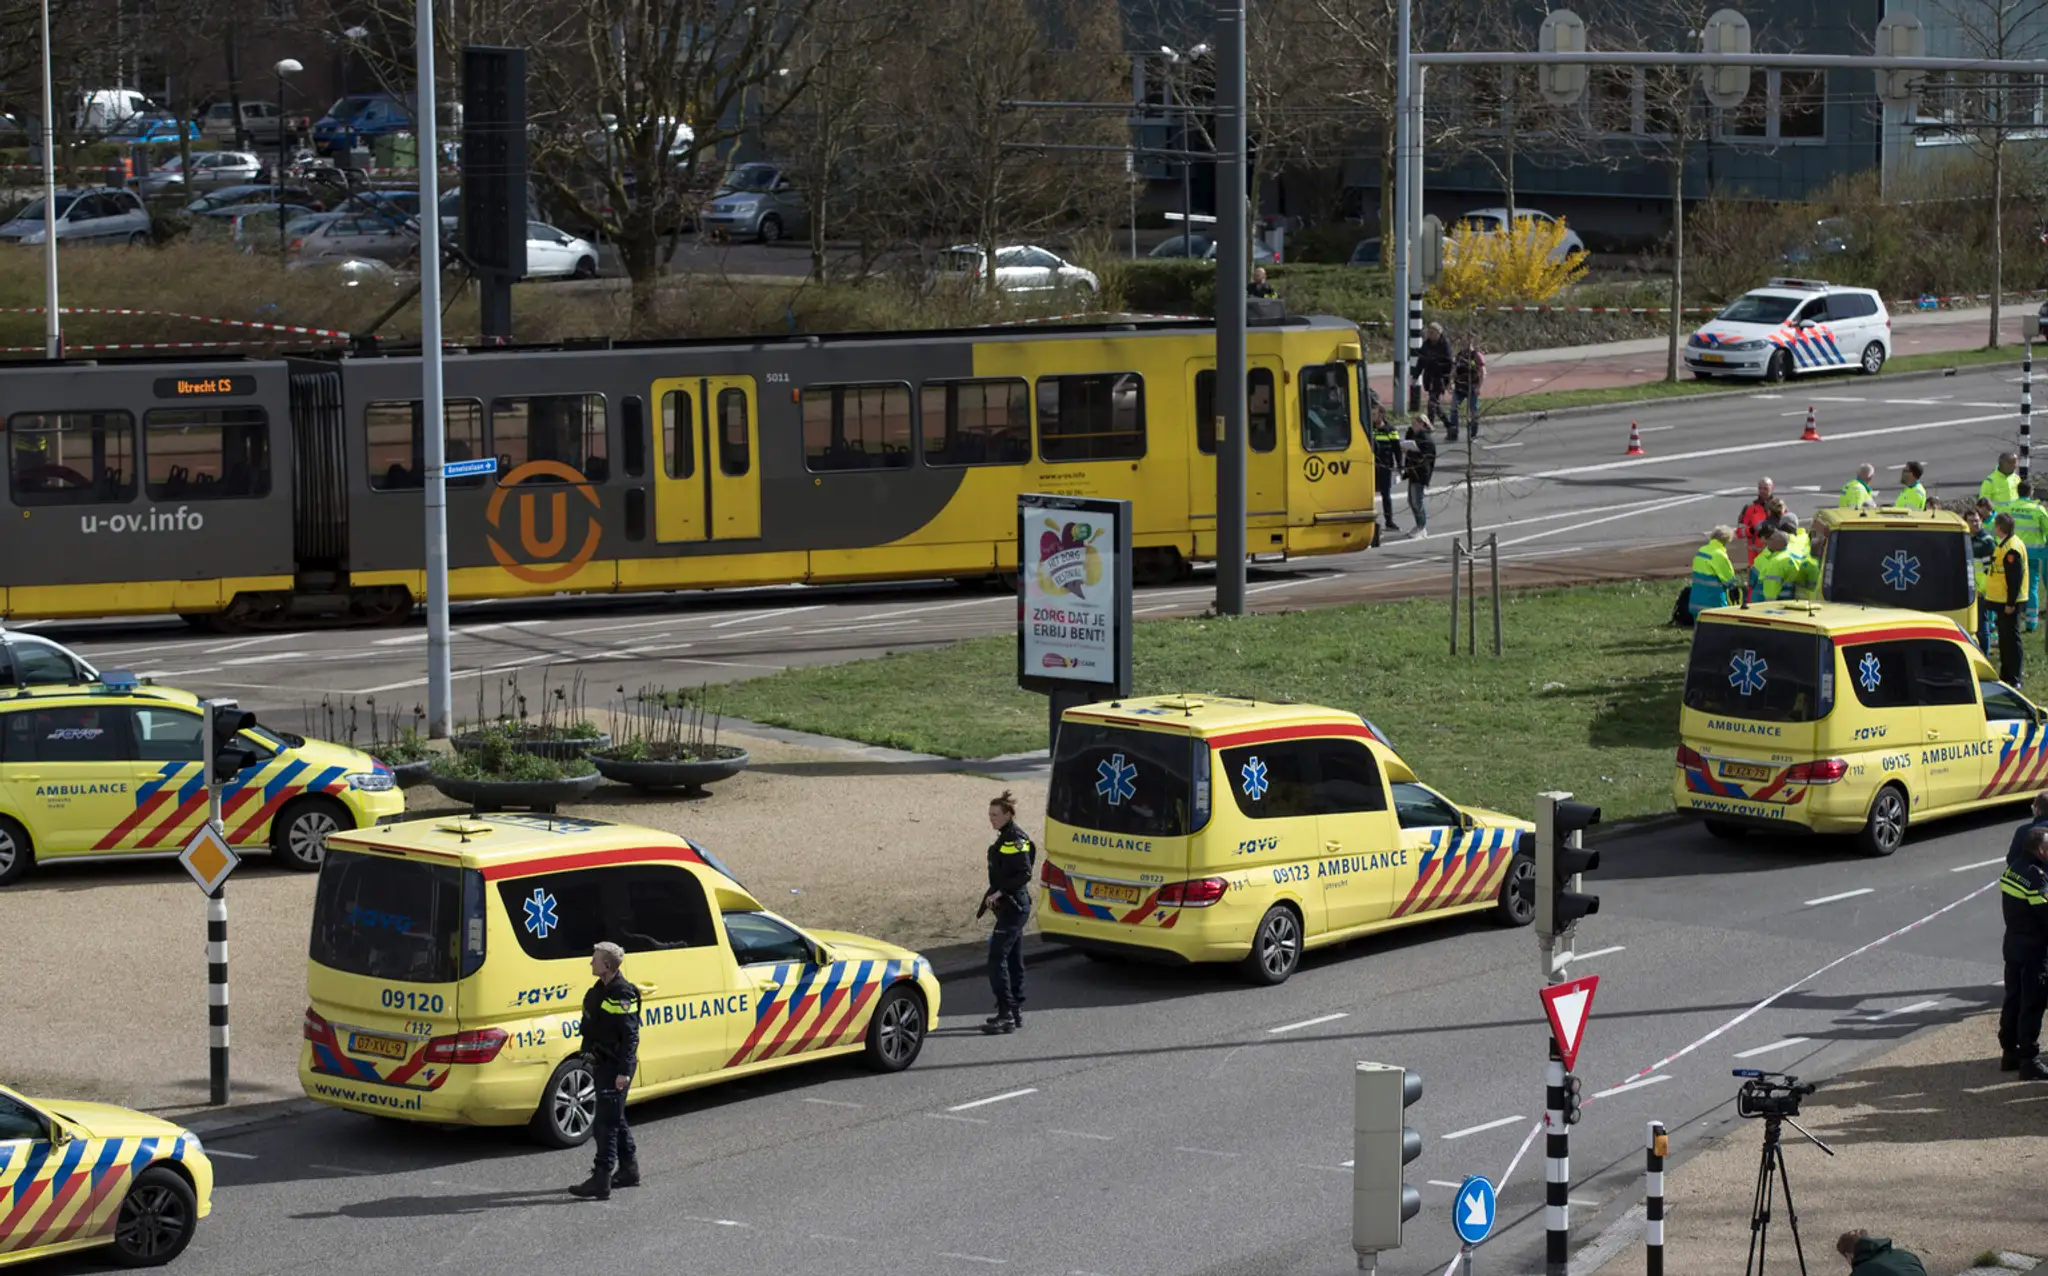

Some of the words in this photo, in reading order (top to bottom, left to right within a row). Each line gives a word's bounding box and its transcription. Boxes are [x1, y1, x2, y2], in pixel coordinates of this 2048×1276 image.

[177, 380, 216, 393] Utrecht
[218, 379, 231, 392] CS
[766, 372, 790, 382] 5011
[81, 505, 204, 533] u-ov.info
[1033, 608, 1066, 623] ZORG
[1067, 611, 1090, 625] DAT
[1092, 614, 1105, 627] JE
[1033, 623, 1067, 638] ERBIJ
[1070, 627, 1106, 643] BENT!
[1707, 720, 1782, 736] AMBULANCE
[1882, 753, 1911, 771] 09125
[1921, 740, 1993, 765] AMBULANCE
[35, 783, 128, 796] AMBULANCE
[1691, 799, 1786, 819] www.ravu.nl
[1072, 832, 1152, 853] AMBULANCE
[1272, 864, 1310, 884] 09123
[1317, 849, 1408, 878] AMBULANCE
[381, 988, 444, 1013] 09120
[638, 994, 749, 1028] MBULANCE
[315, 1083, 422, 1111] www.ravu.nl
